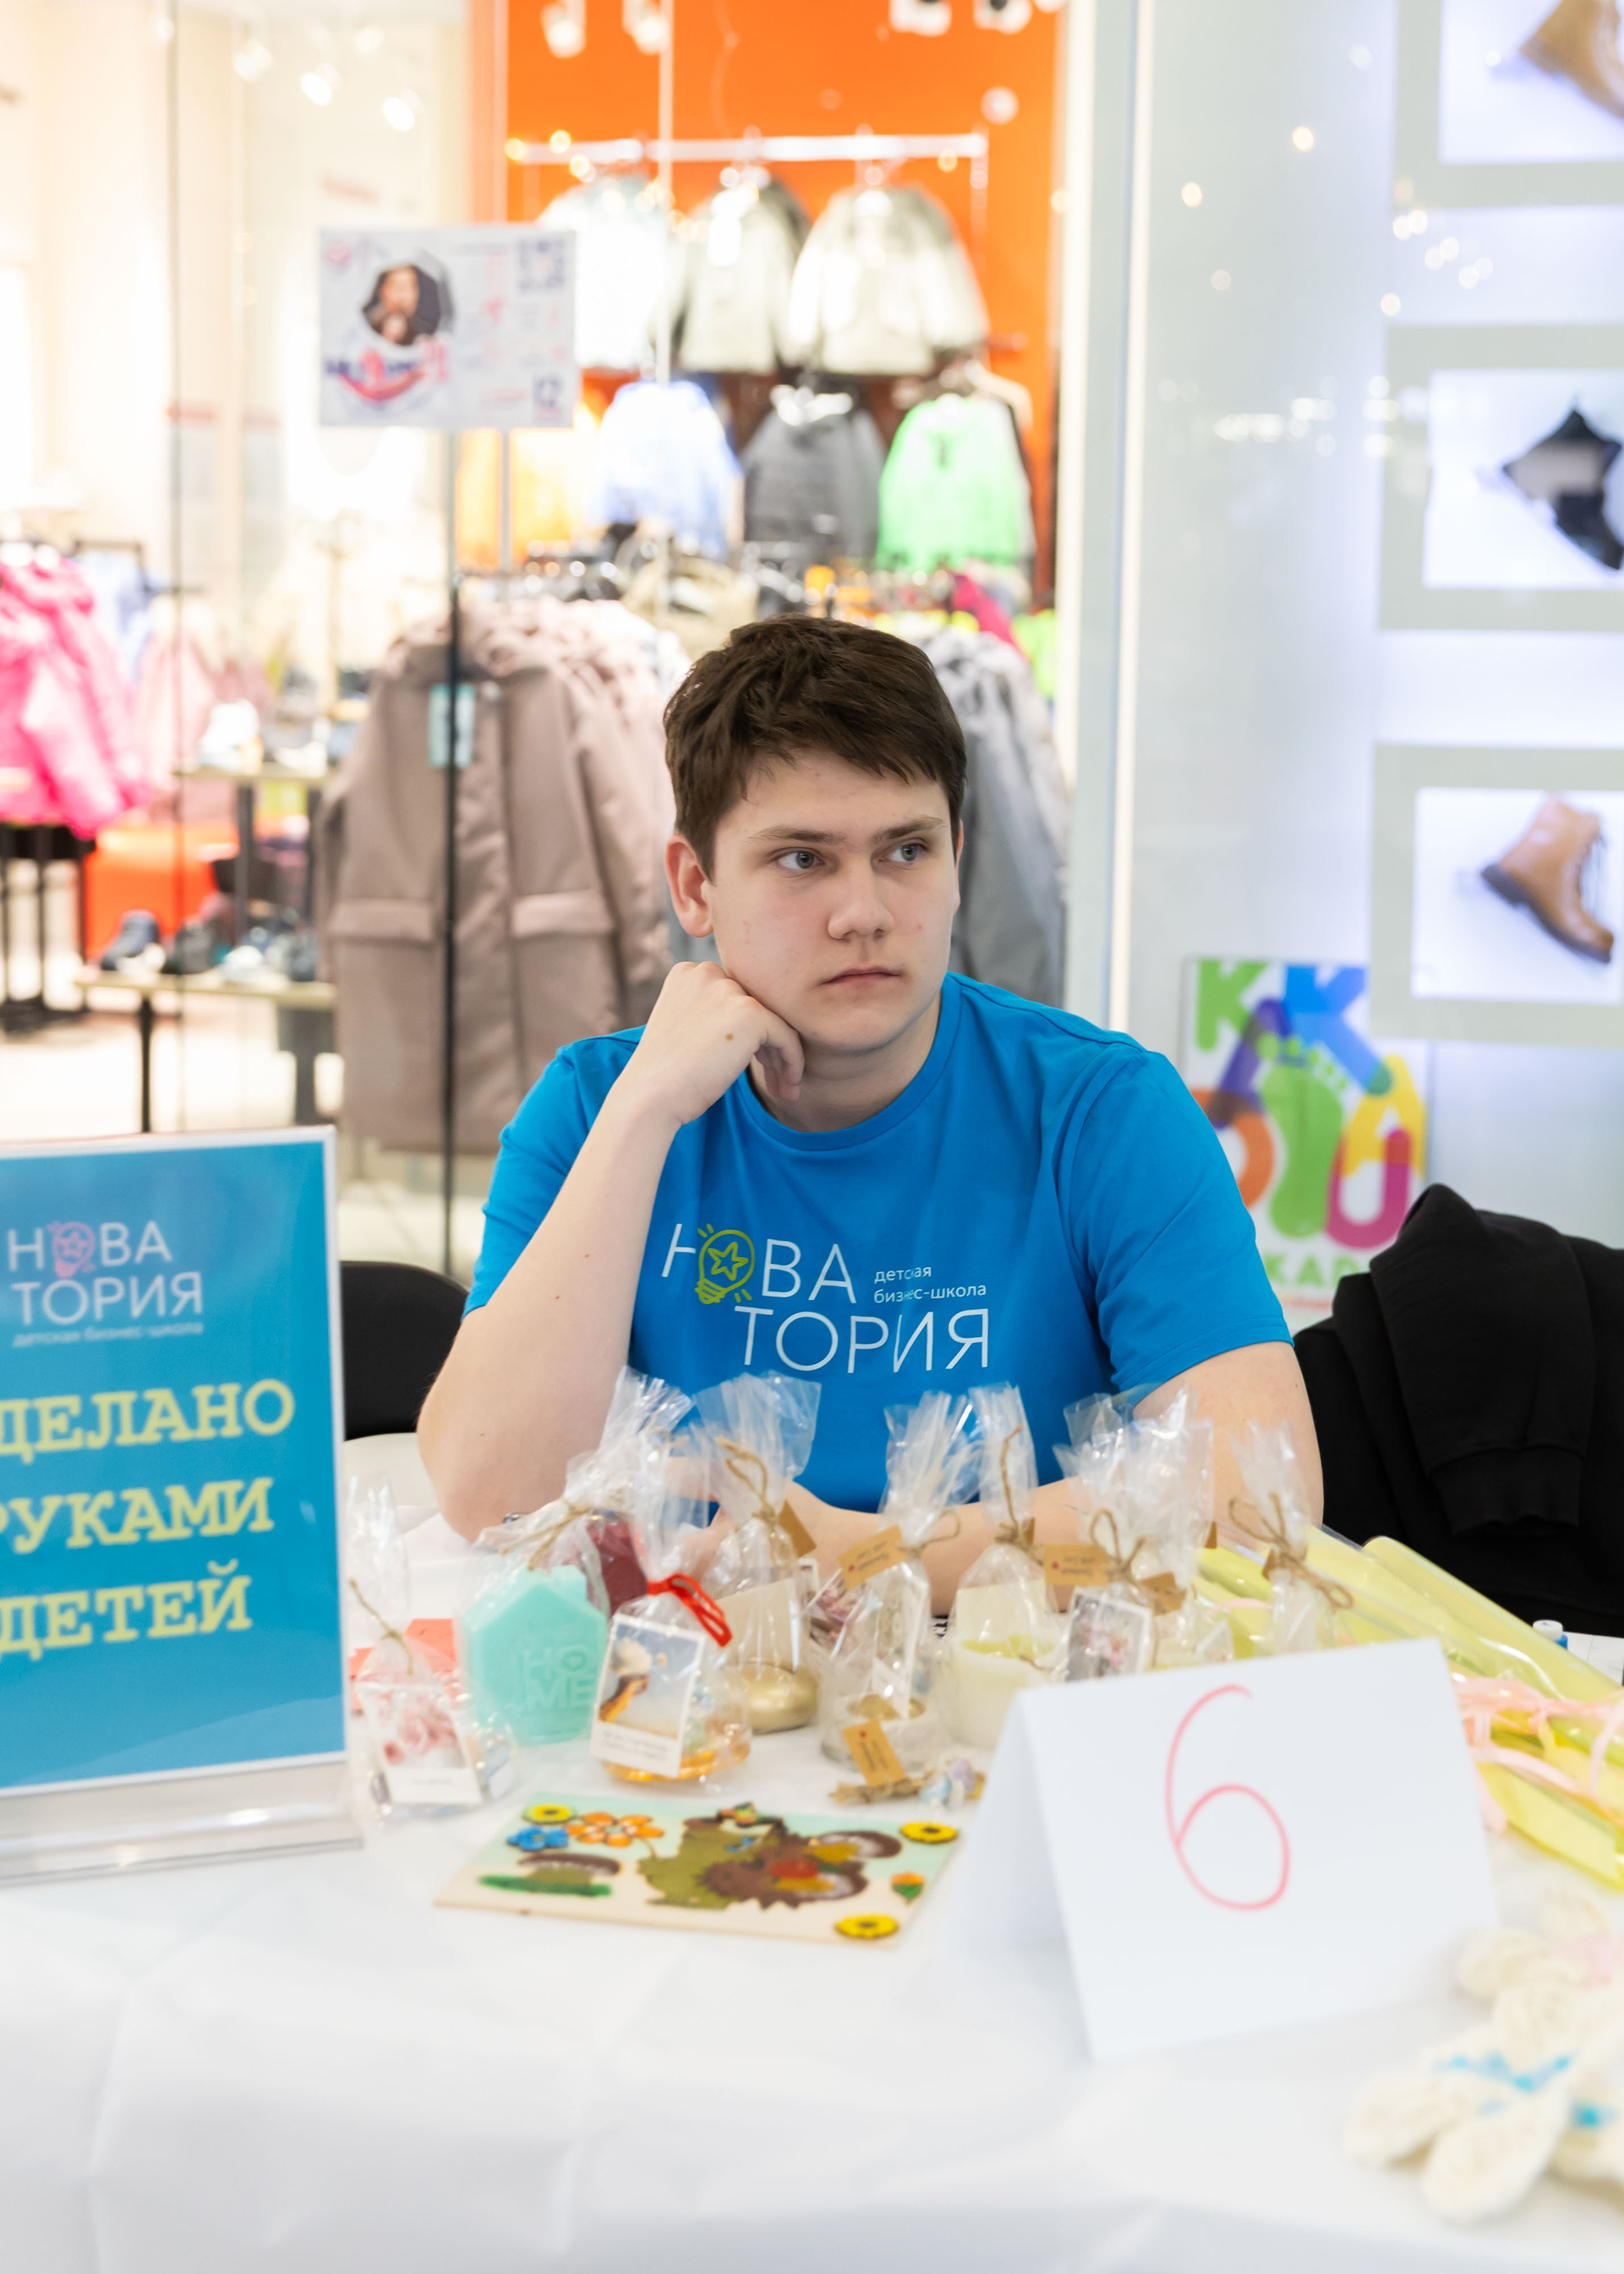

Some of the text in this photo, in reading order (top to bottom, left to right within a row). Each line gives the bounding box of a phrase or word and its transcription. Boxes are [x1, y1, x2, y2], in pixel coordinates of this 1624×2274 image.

[11, 1272, 203, 1325] ТОРИЯ
[874, 1266, 931, 1284] детсая
[734, 1306, 988, 1374] ТОРИЯ
[0, 1478, 273, 1554] УКАМИ
[0, 1558, 252, 1662] ДЕТЕЙ
[1165, 1683, 1292, 1912] 6
